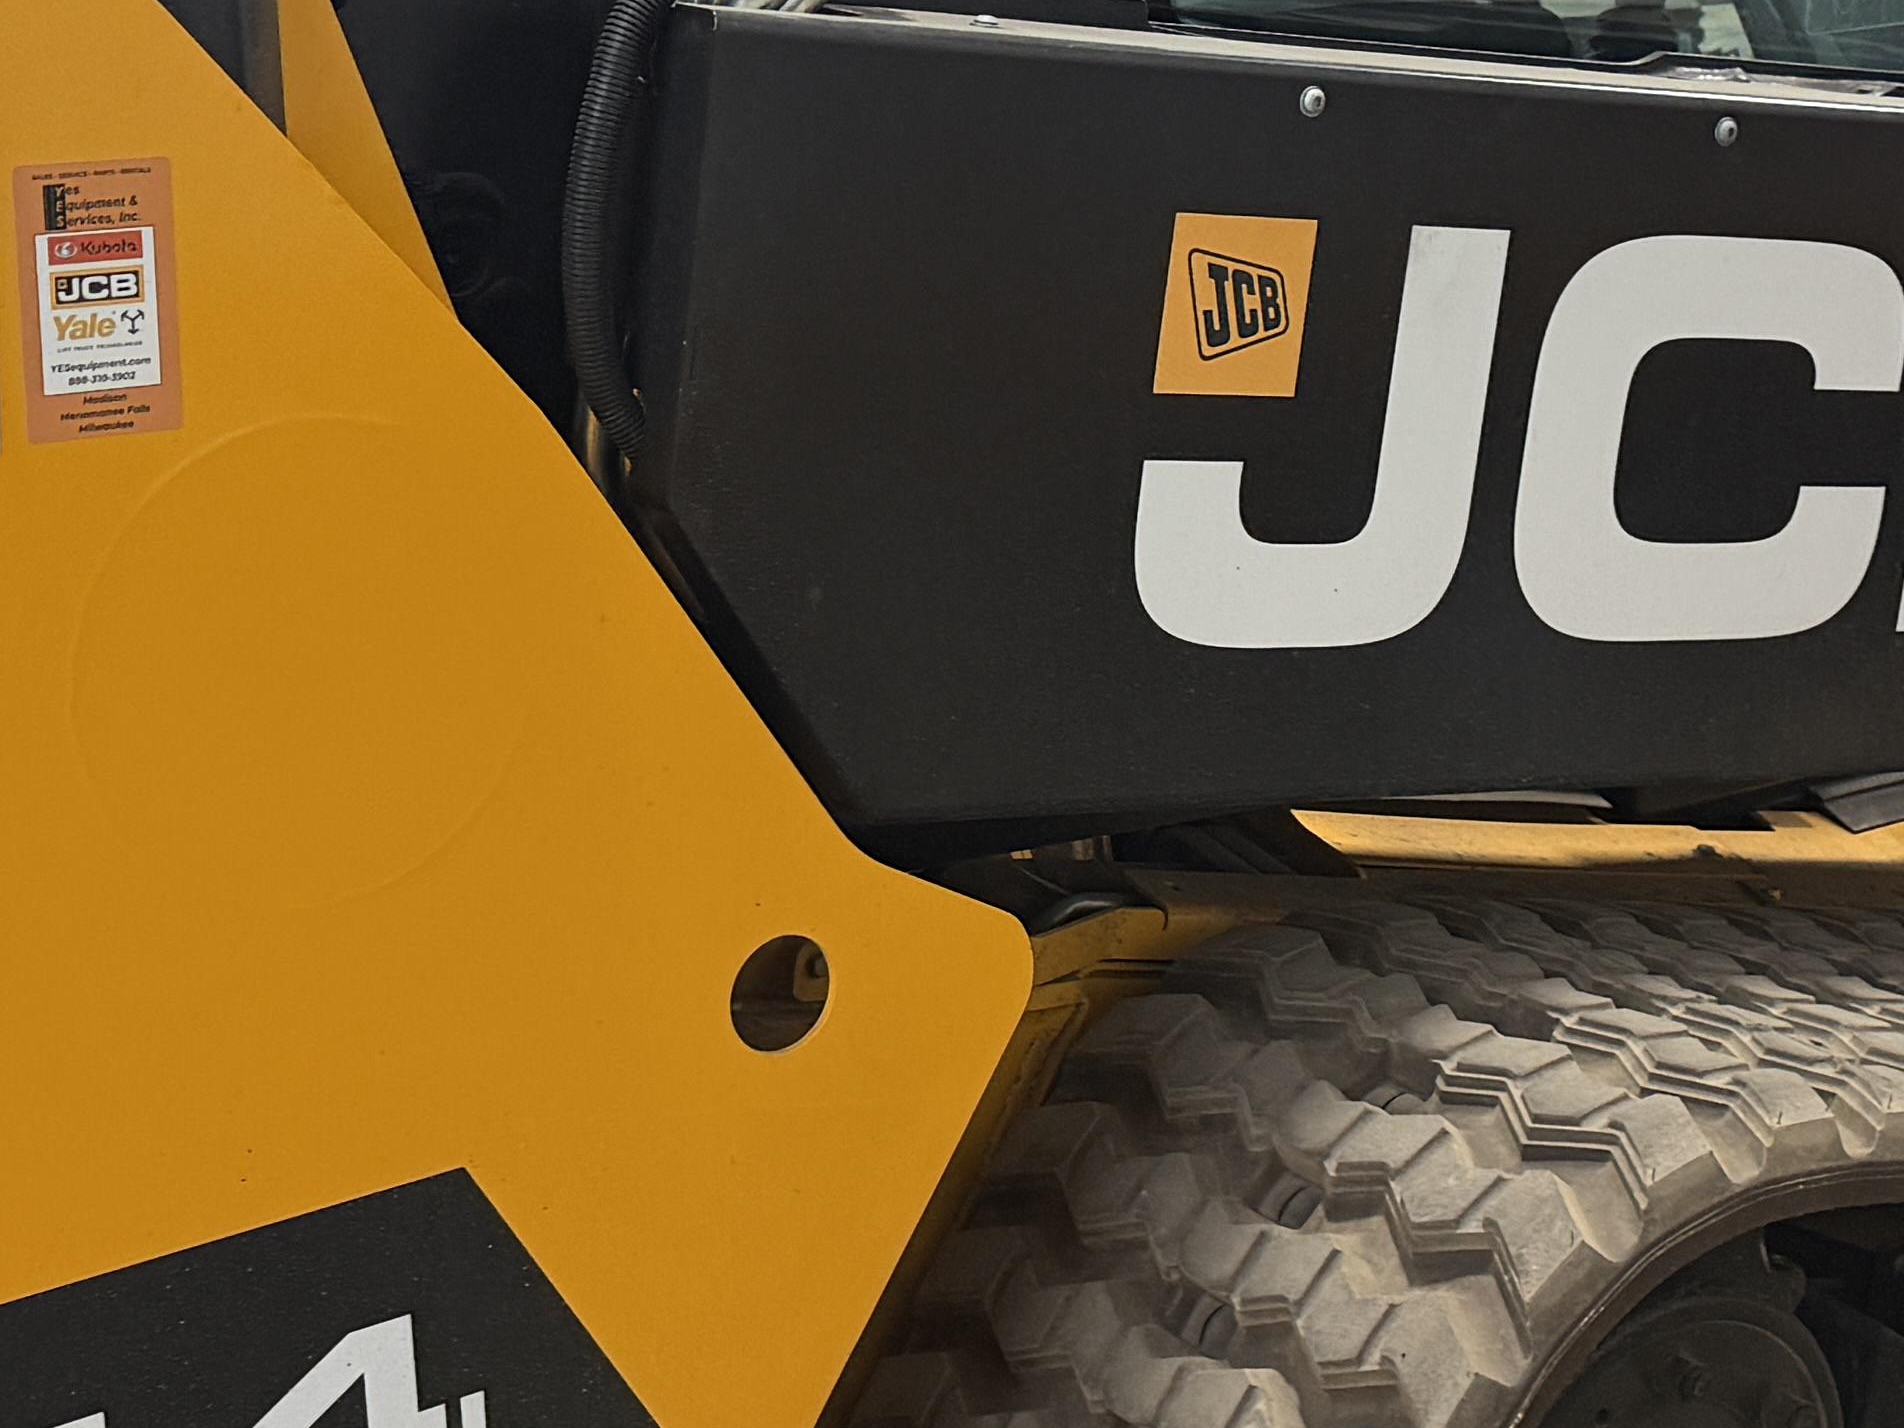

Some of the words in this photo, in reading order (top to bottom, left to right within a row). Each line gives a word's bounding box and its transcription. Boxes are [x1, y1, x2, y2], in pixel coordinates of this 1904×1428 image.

[56, 197, 126, 213] Equipment
[130, 195, 138, 206] &
[80, 239, 138, 255] Kubota
[57, 273, 138, 302] JCB
[1203, 262, 1282, 348] JCB
[53, 313, 117, 341] Yale
[51, 356, 152, 374] YESequipment.com
